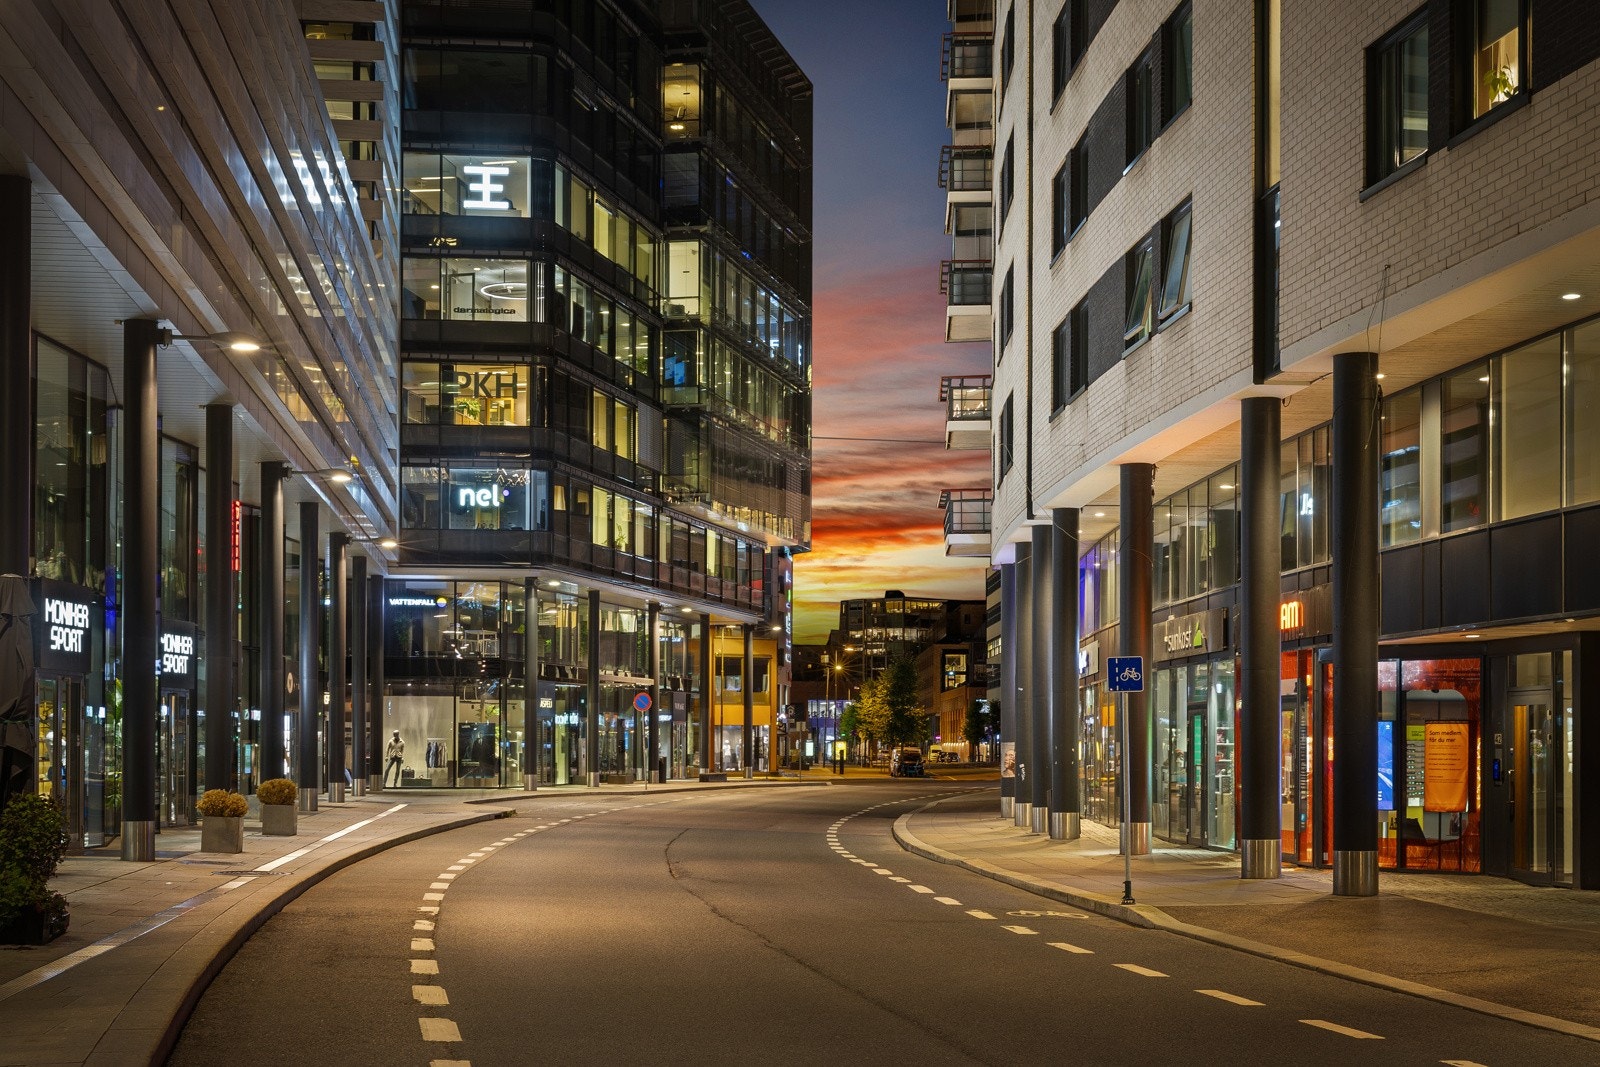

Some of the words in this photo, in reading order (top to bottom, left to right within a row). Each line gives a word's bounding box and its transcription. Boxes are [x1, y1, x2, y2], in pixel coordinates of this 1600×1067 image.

[453, 306, 516, 315] dermalogica
[453, 371, 517, 399] PKH
[460, 484, 499, 506] nel
[389, 598, 436, 606] VATTENFALL
[50, 625, 84, 653] SPORT
[163, 653, 189, 674] SPORT
